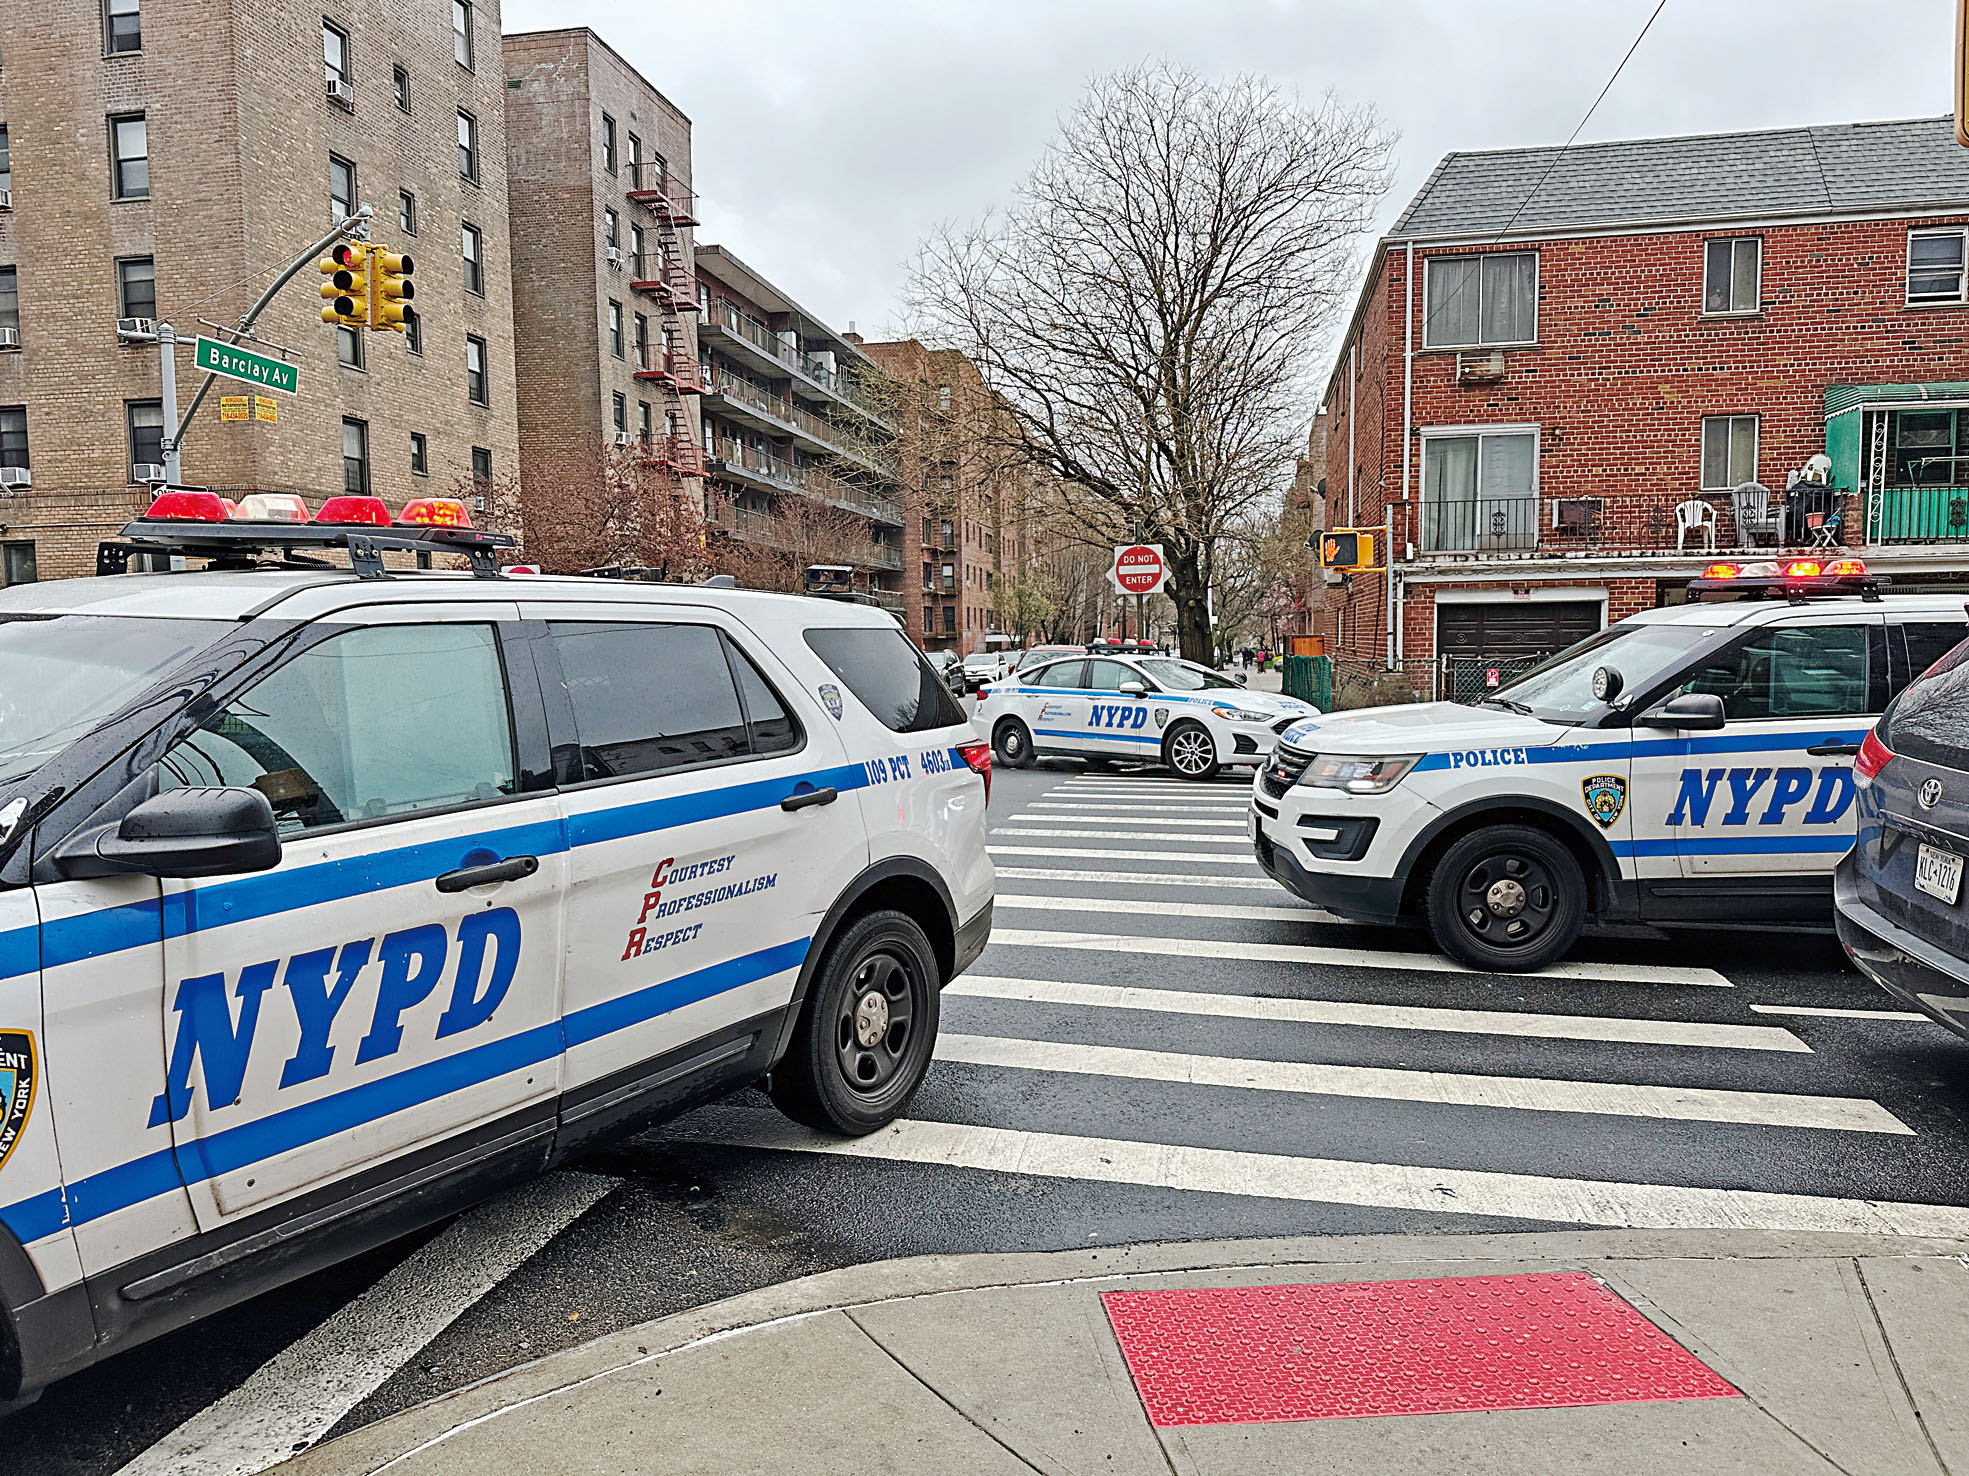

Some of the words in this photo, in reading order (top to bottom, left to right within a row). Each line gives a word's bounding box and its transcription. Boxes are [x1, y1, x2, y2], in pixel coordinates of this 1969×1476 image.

[210, 347, 269, 383] Barclay
[272, 367, 289, 385] Av
[1123, 555, 1135, 564] DO
[1137, 554, 1154, 563] NOT
[1125, 575, 1153, 585] ENTER
[1087, 704, 1148, 729] NYPD
[1188, 697, 1214, 706] POLICE
[865, 758, 888, 786] 109
[887, 754, 912, 782] PCT
[1451, 748, 1526, 769] POLICE
[1584, 782, 1624, 794] DEPARTMENT
[1592, 776, 1616, 785] POLICE
[1664, 766, 1856, 826] NYPD
[651, 855, 736, 889] COURTESY
[636, 873, 778, 925] PROFESSIONALISM
[620, 923, 703, 962] RESPECT
[146, 906, 522, 1130] NYPD
[11, 1077, 31, 1120] YORK
